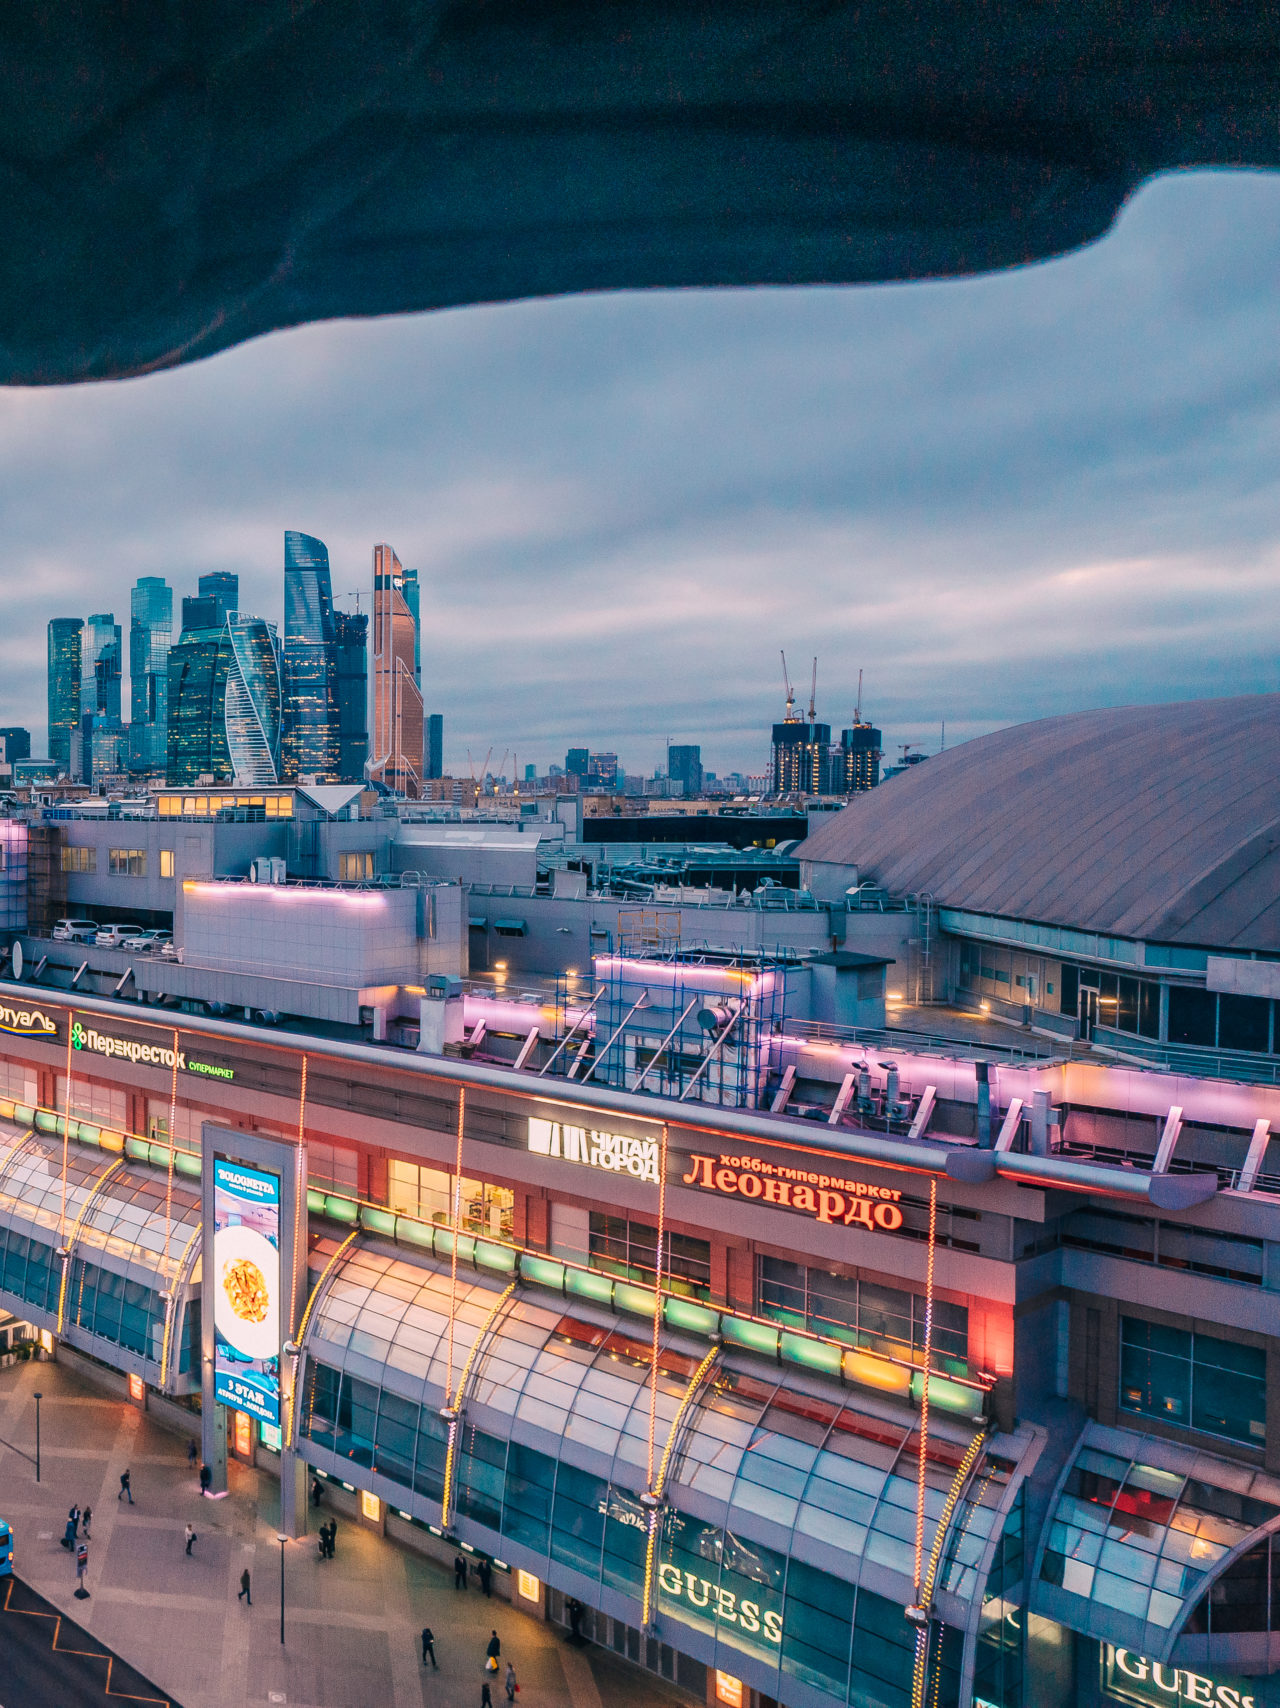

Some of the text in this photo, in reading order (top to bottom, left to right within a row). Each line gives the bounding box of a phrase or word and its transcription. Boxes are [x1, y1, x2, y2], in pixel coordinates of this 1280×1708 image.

[188, 1061, 235, 1080] СУПЕРМАРКЕТ
[589, 1148, 661, 1185] ГОРОД
[590, 1129, 660, 1162] ЧИТАЙ
[682, 1154, 904, 1232] Леонардо
[719, 1154, 902, 1202] хобби-гипермаркет
[658, 1563, 784, 1643] GUESS
